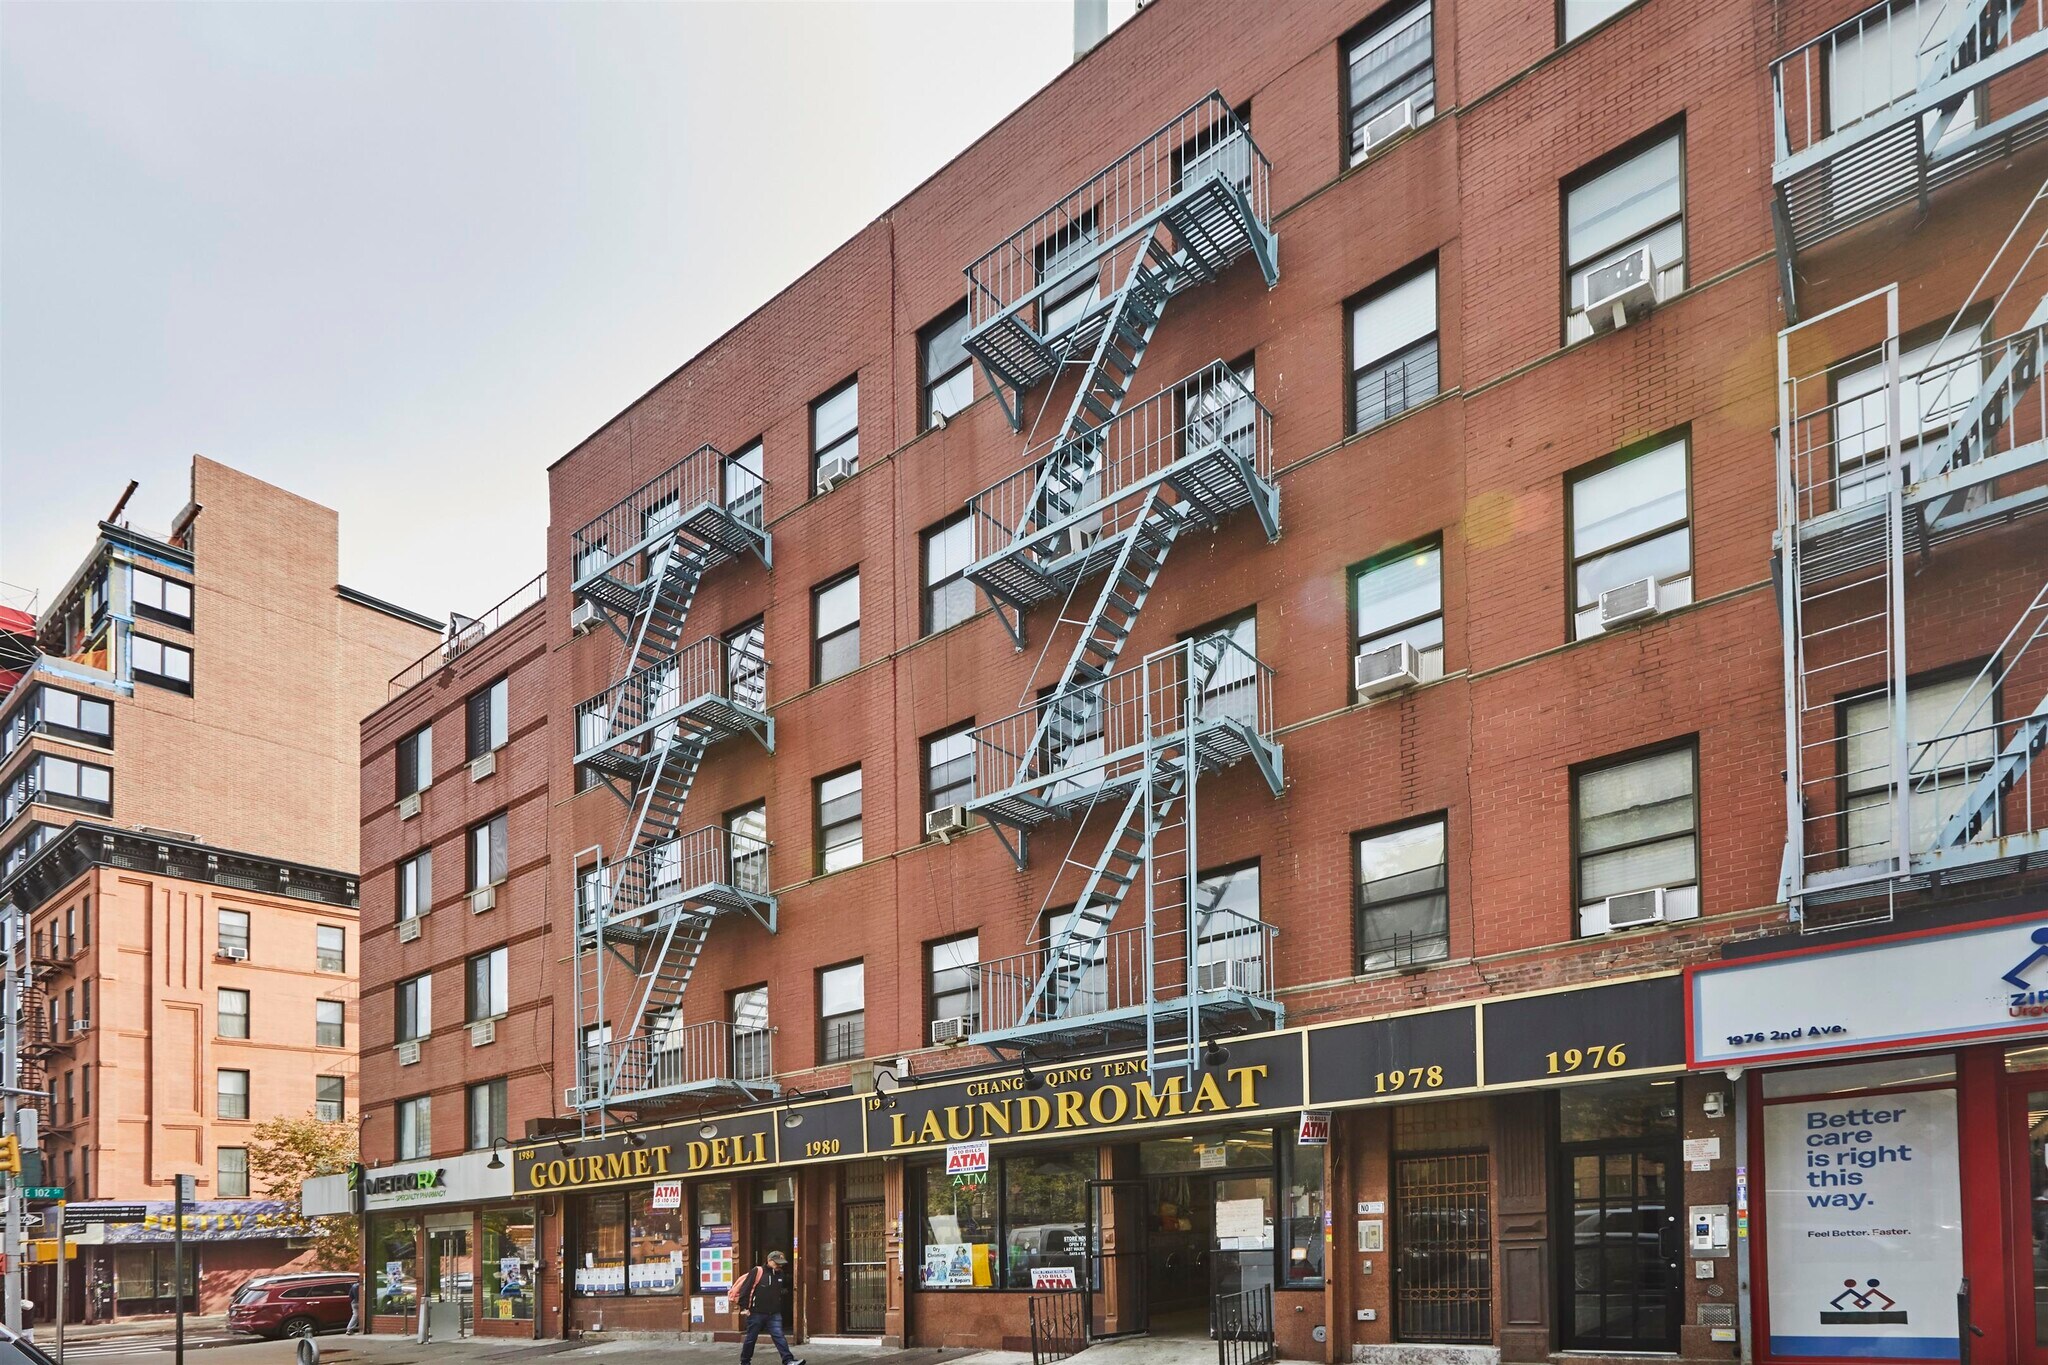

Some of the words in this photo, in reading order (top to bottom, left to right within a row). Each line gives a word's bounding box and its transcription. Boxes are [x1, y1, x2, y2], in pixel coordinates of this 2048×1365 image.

[1726, 1031, 1765, 1046] 1976
[1770, 1027, 1802, 1041] 2nd
[1807, 1023, 1848, 1037] Ave.
[1545, 1043, 1627, 1074] 1976
[966, 1077, 1024, 1097] CHANG
[1045, 1066, 1093, 1088] QING
[1374, 1065, 1444, 1093] 1978
[889, 1064, 1268, 1148] LAUNDROMAT
[1806, 1107, 1907, 1130] Better
[1301, 1121, 1328, 1138] ATM
[1806, 1129, 1873, 1148] care
[805, 1138, 841, 1157] 1980
[1806, 1150, 1830, 1168] is
[1837, 1144, 1912, 1169] right
[530, 1145, 672, 1189] GOURMET
[687, 1132, 769, 1172] DELI
[948, 1152, 986, 1169] ATM
[952, 1172, 987, 1187] ATM
[1806, 1168, 1863, 1188] this
[25, 1188, 30, 1197] E
[35, 1188, 50, 1197] 102
[655, 1186, 680, 1198] ATM
[1807, 1191, 1874, 1211] way.
[1360, 1204, 1369, 1212] NO
[144, 1213, 247, 1231] PRETTY
[1807, 1229, 1830, 1238] Feel
[1832, 1229, 1870, 1238] Better.
[1872, 1228, 1912, 1237] Faster.
[592, 1260, 625, 1269] ourmet
[1035, 1278, 1074, 1289] ATM
